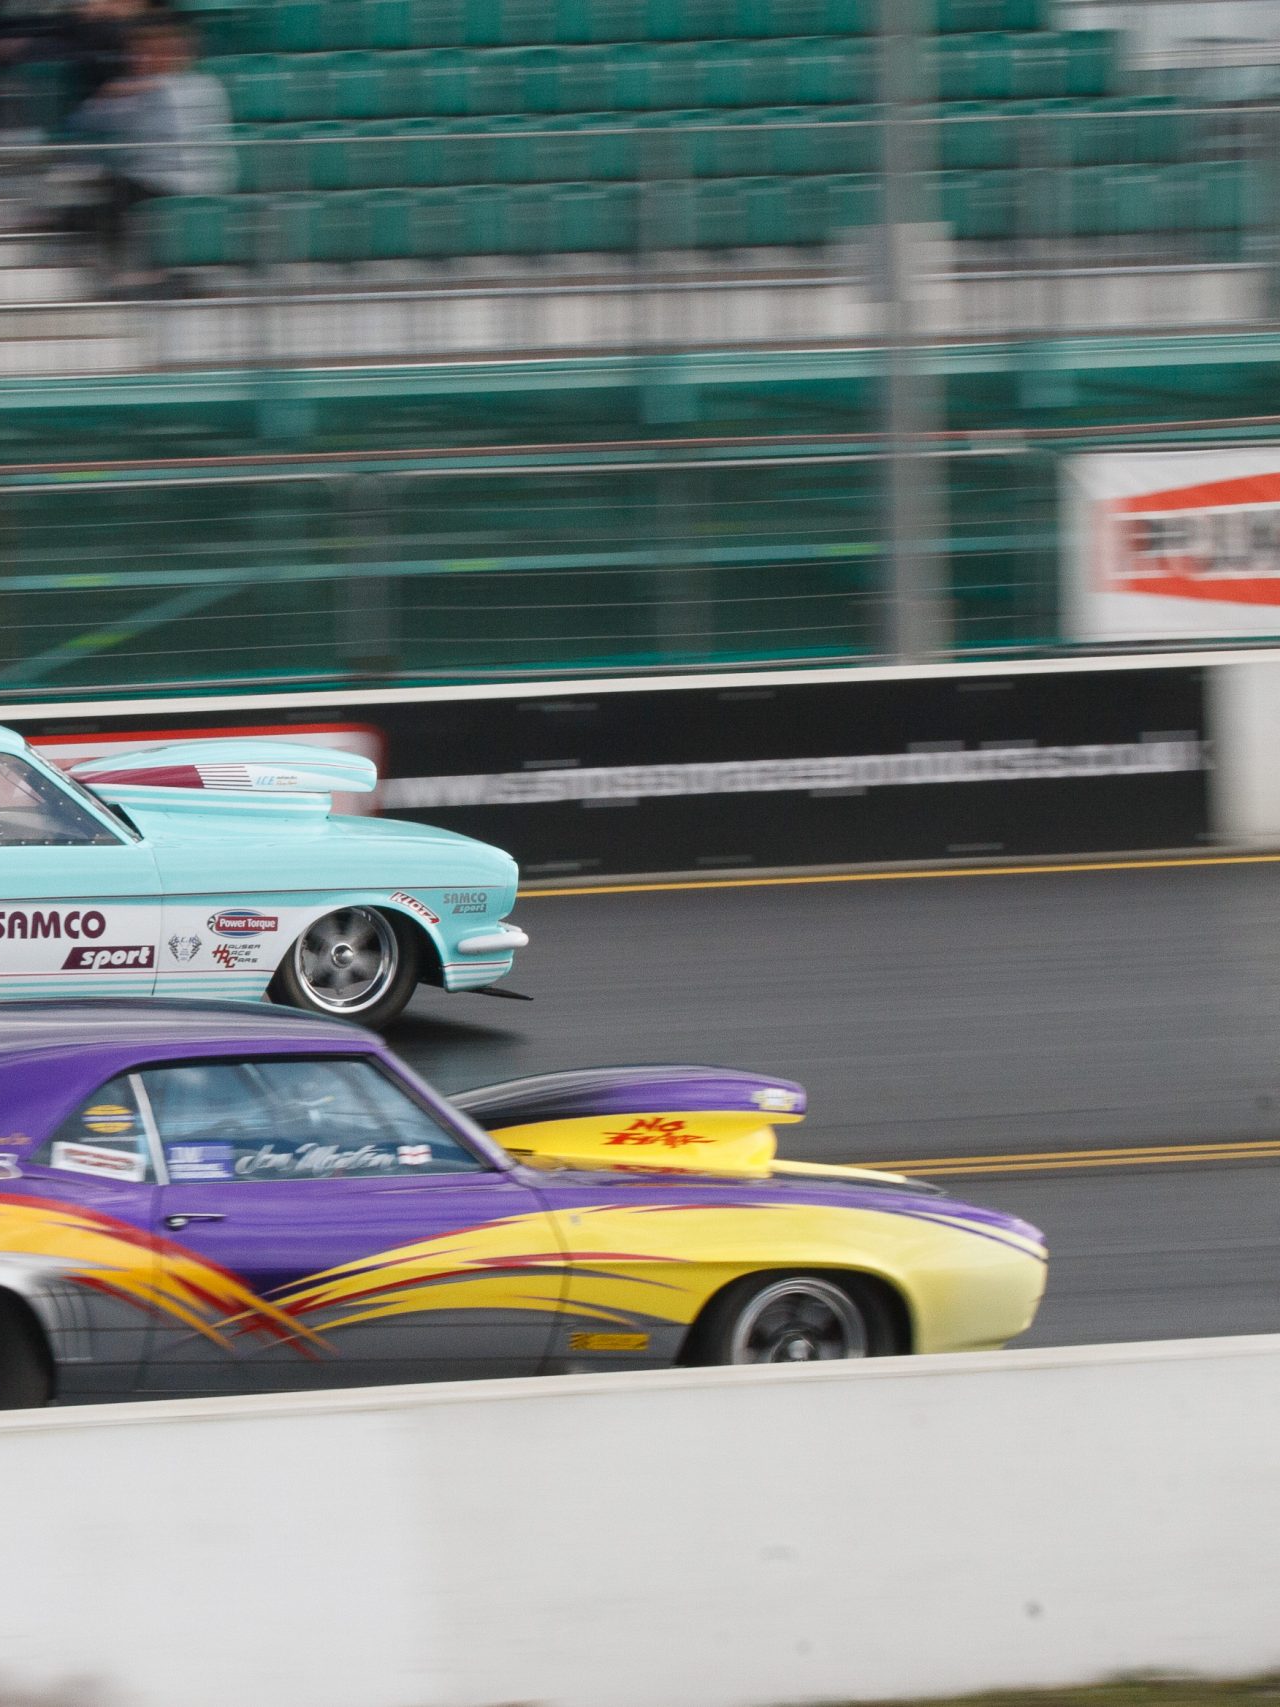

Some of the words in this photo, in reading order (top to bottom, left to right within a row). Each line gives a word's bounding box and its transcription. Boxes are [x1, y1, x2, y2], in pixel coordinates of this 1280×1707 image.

[443, 892, 488, 904] SAMCO
[391, 892, 438, 923] KLOTZ
[460, 904, 487, 913] sport
[220, 918, 246, 928] Power
[247, 918, 276, 930] Torque
[80, 946, 151, 969] sport
